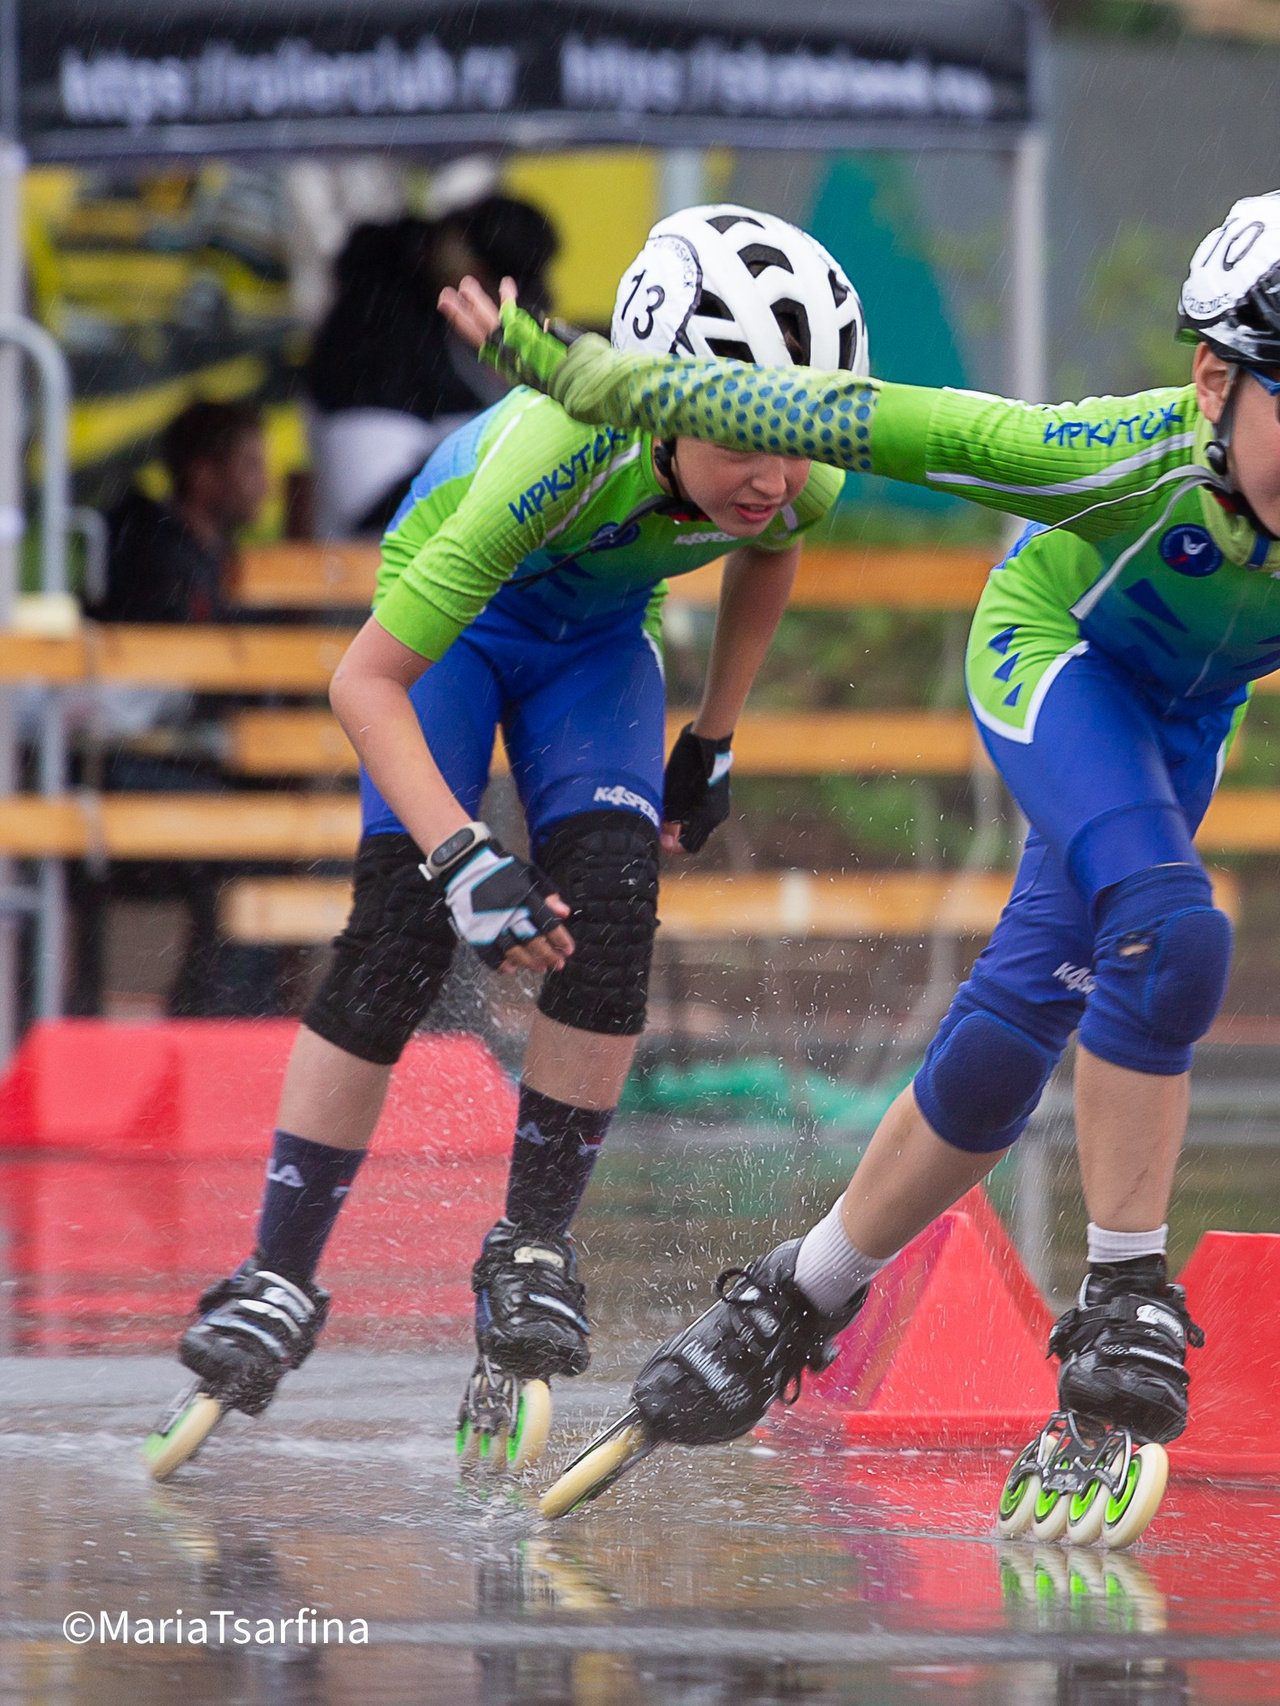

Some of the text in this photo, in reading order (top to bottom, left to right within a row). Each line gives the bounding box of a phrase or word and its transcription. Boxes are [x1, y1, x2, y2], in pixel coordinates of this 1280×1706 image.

[1201, 216, 1265, 272] 10
[621, 268, 666, 340] 13
[1043, 402, 1183, 448] ИРКУТСК
[507, 426, 628, 525] ИРКУТСК
